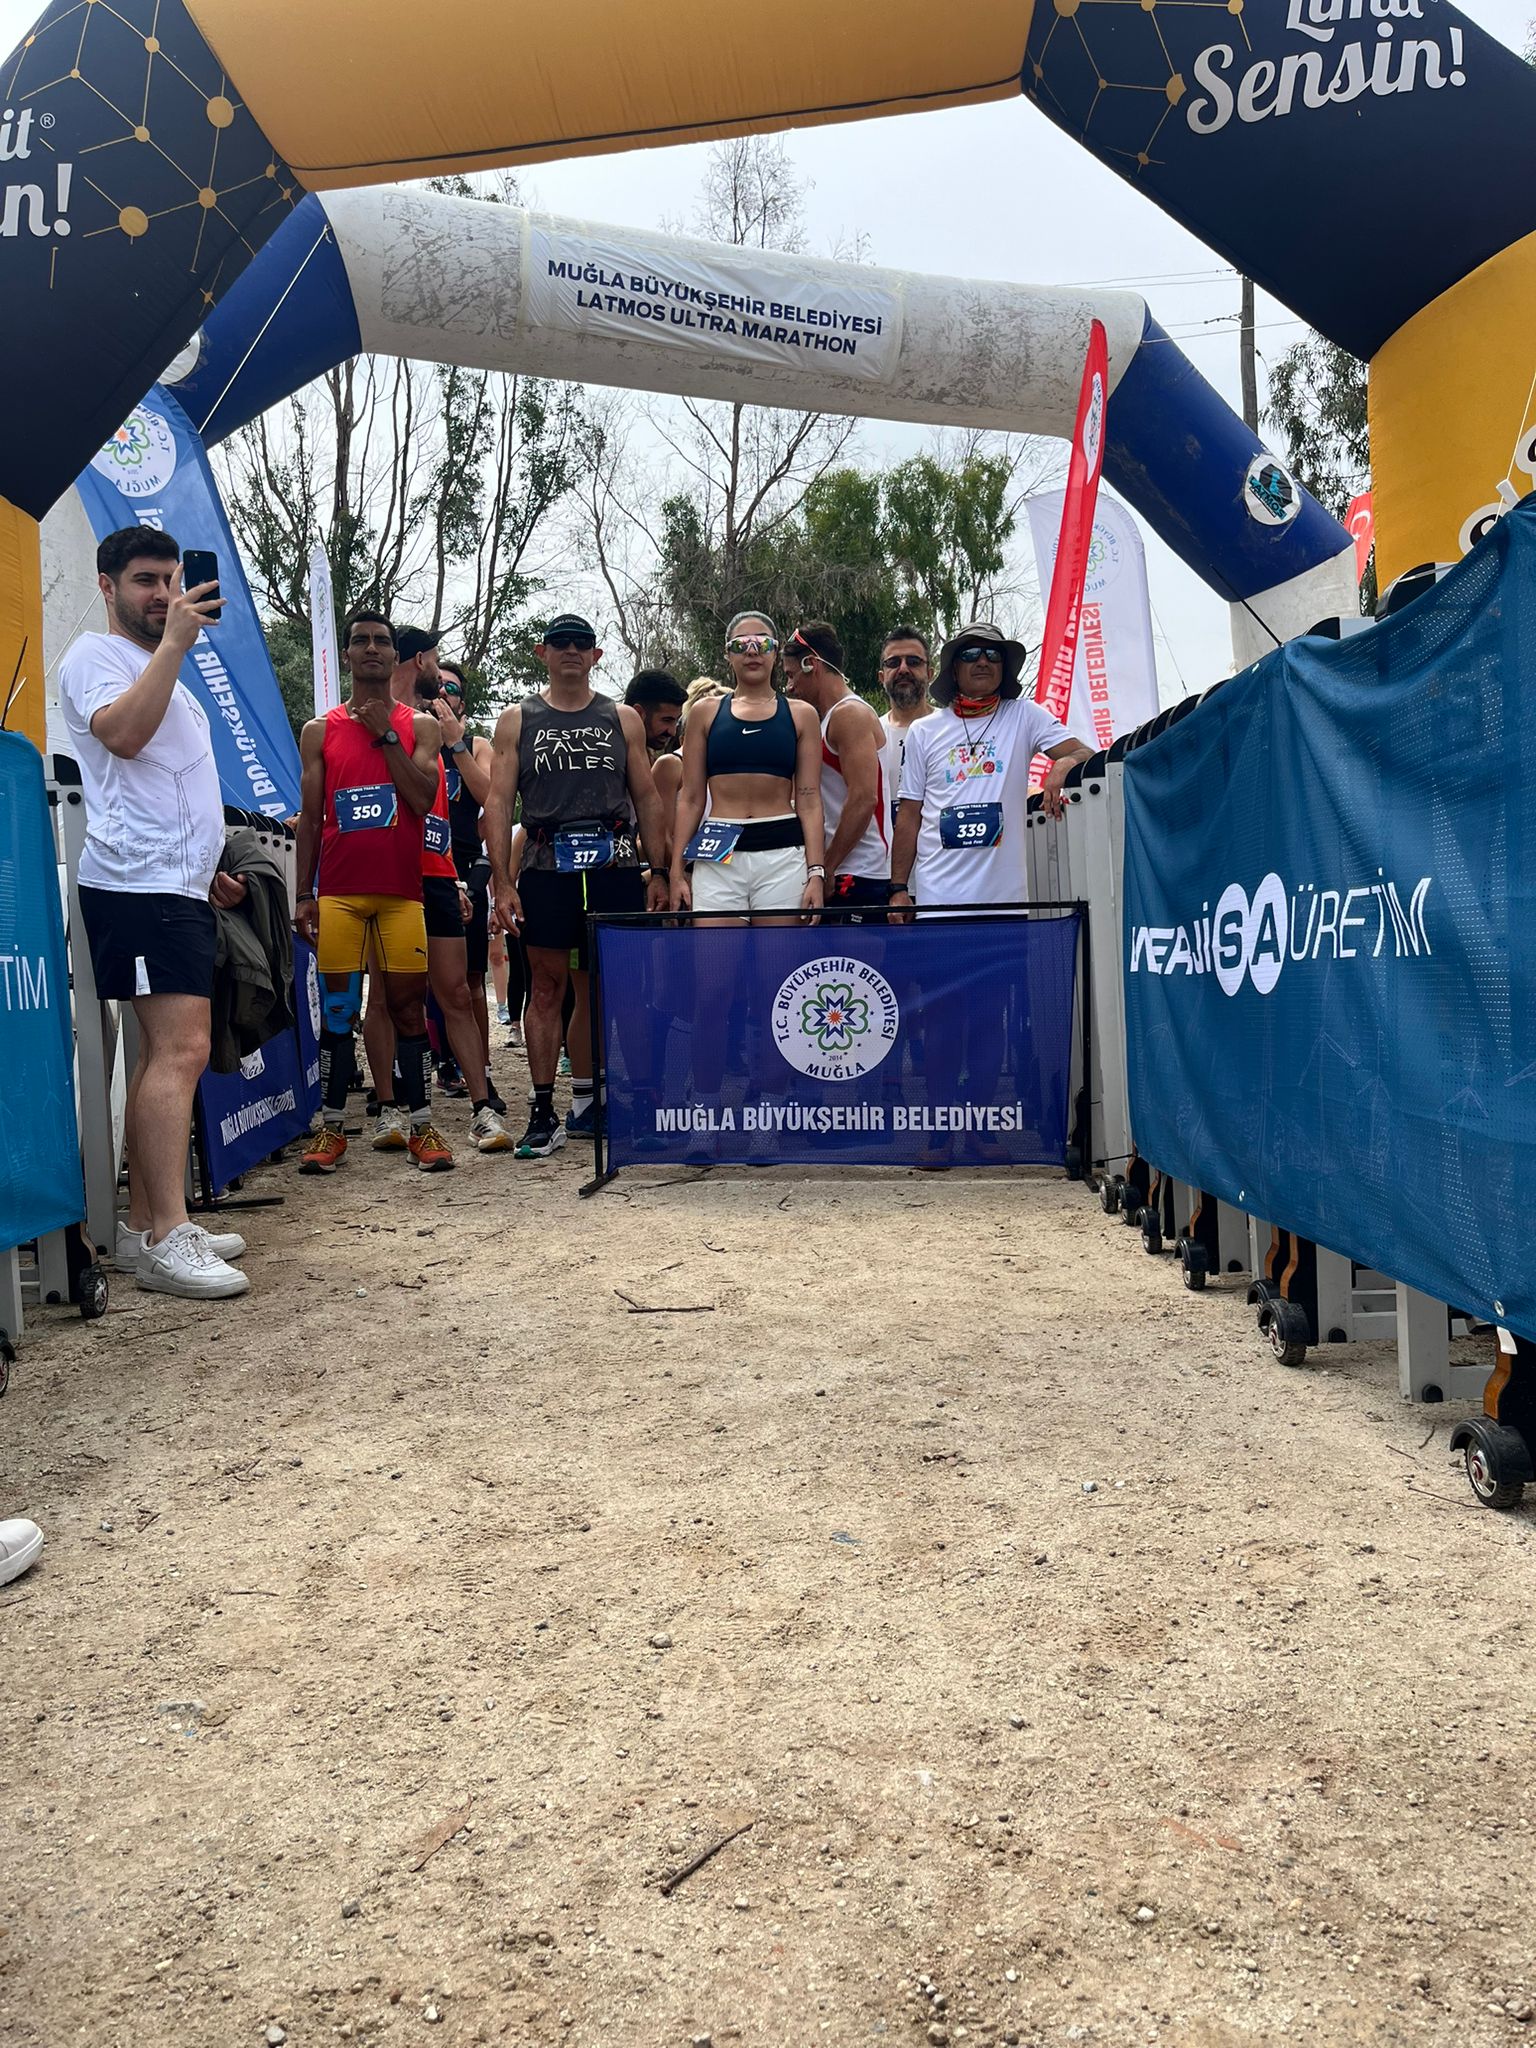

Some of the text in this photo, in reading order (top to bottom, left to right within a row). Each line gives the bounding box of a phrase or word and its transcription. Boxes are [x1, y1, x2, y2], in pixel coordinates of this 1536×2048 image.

[1186, 27, 1466, 134] Sensin!
[548, 260, 882, 336] MUĞLA BÜYÜKŞEHİR BELEDİYESİ
[576, 290, 857, 355] LATMOS ULTRA MARATHON
[534, 727, 613, 746] DESTROY
[534, 752, 615, 775] MILES
[352, 804, 382, 821] 350
[425, 829, 442, 845] 315
[956, 823, 987, 839] 339
[697, 838, 722, 852] 321
[573, 850, 599, 864] 317
[1290, 867, 1432, 961] ÜRETİM
[776, 958, 896, 1043] T.C. BÜYÜKŞEHİR BELEDİYESİ
[805, 1061, 866, 1079] MUĞLA
[655, 1101, 1024, 1134] MUĞLA BÜYÜKŞEHİR BELEDİYESİ
